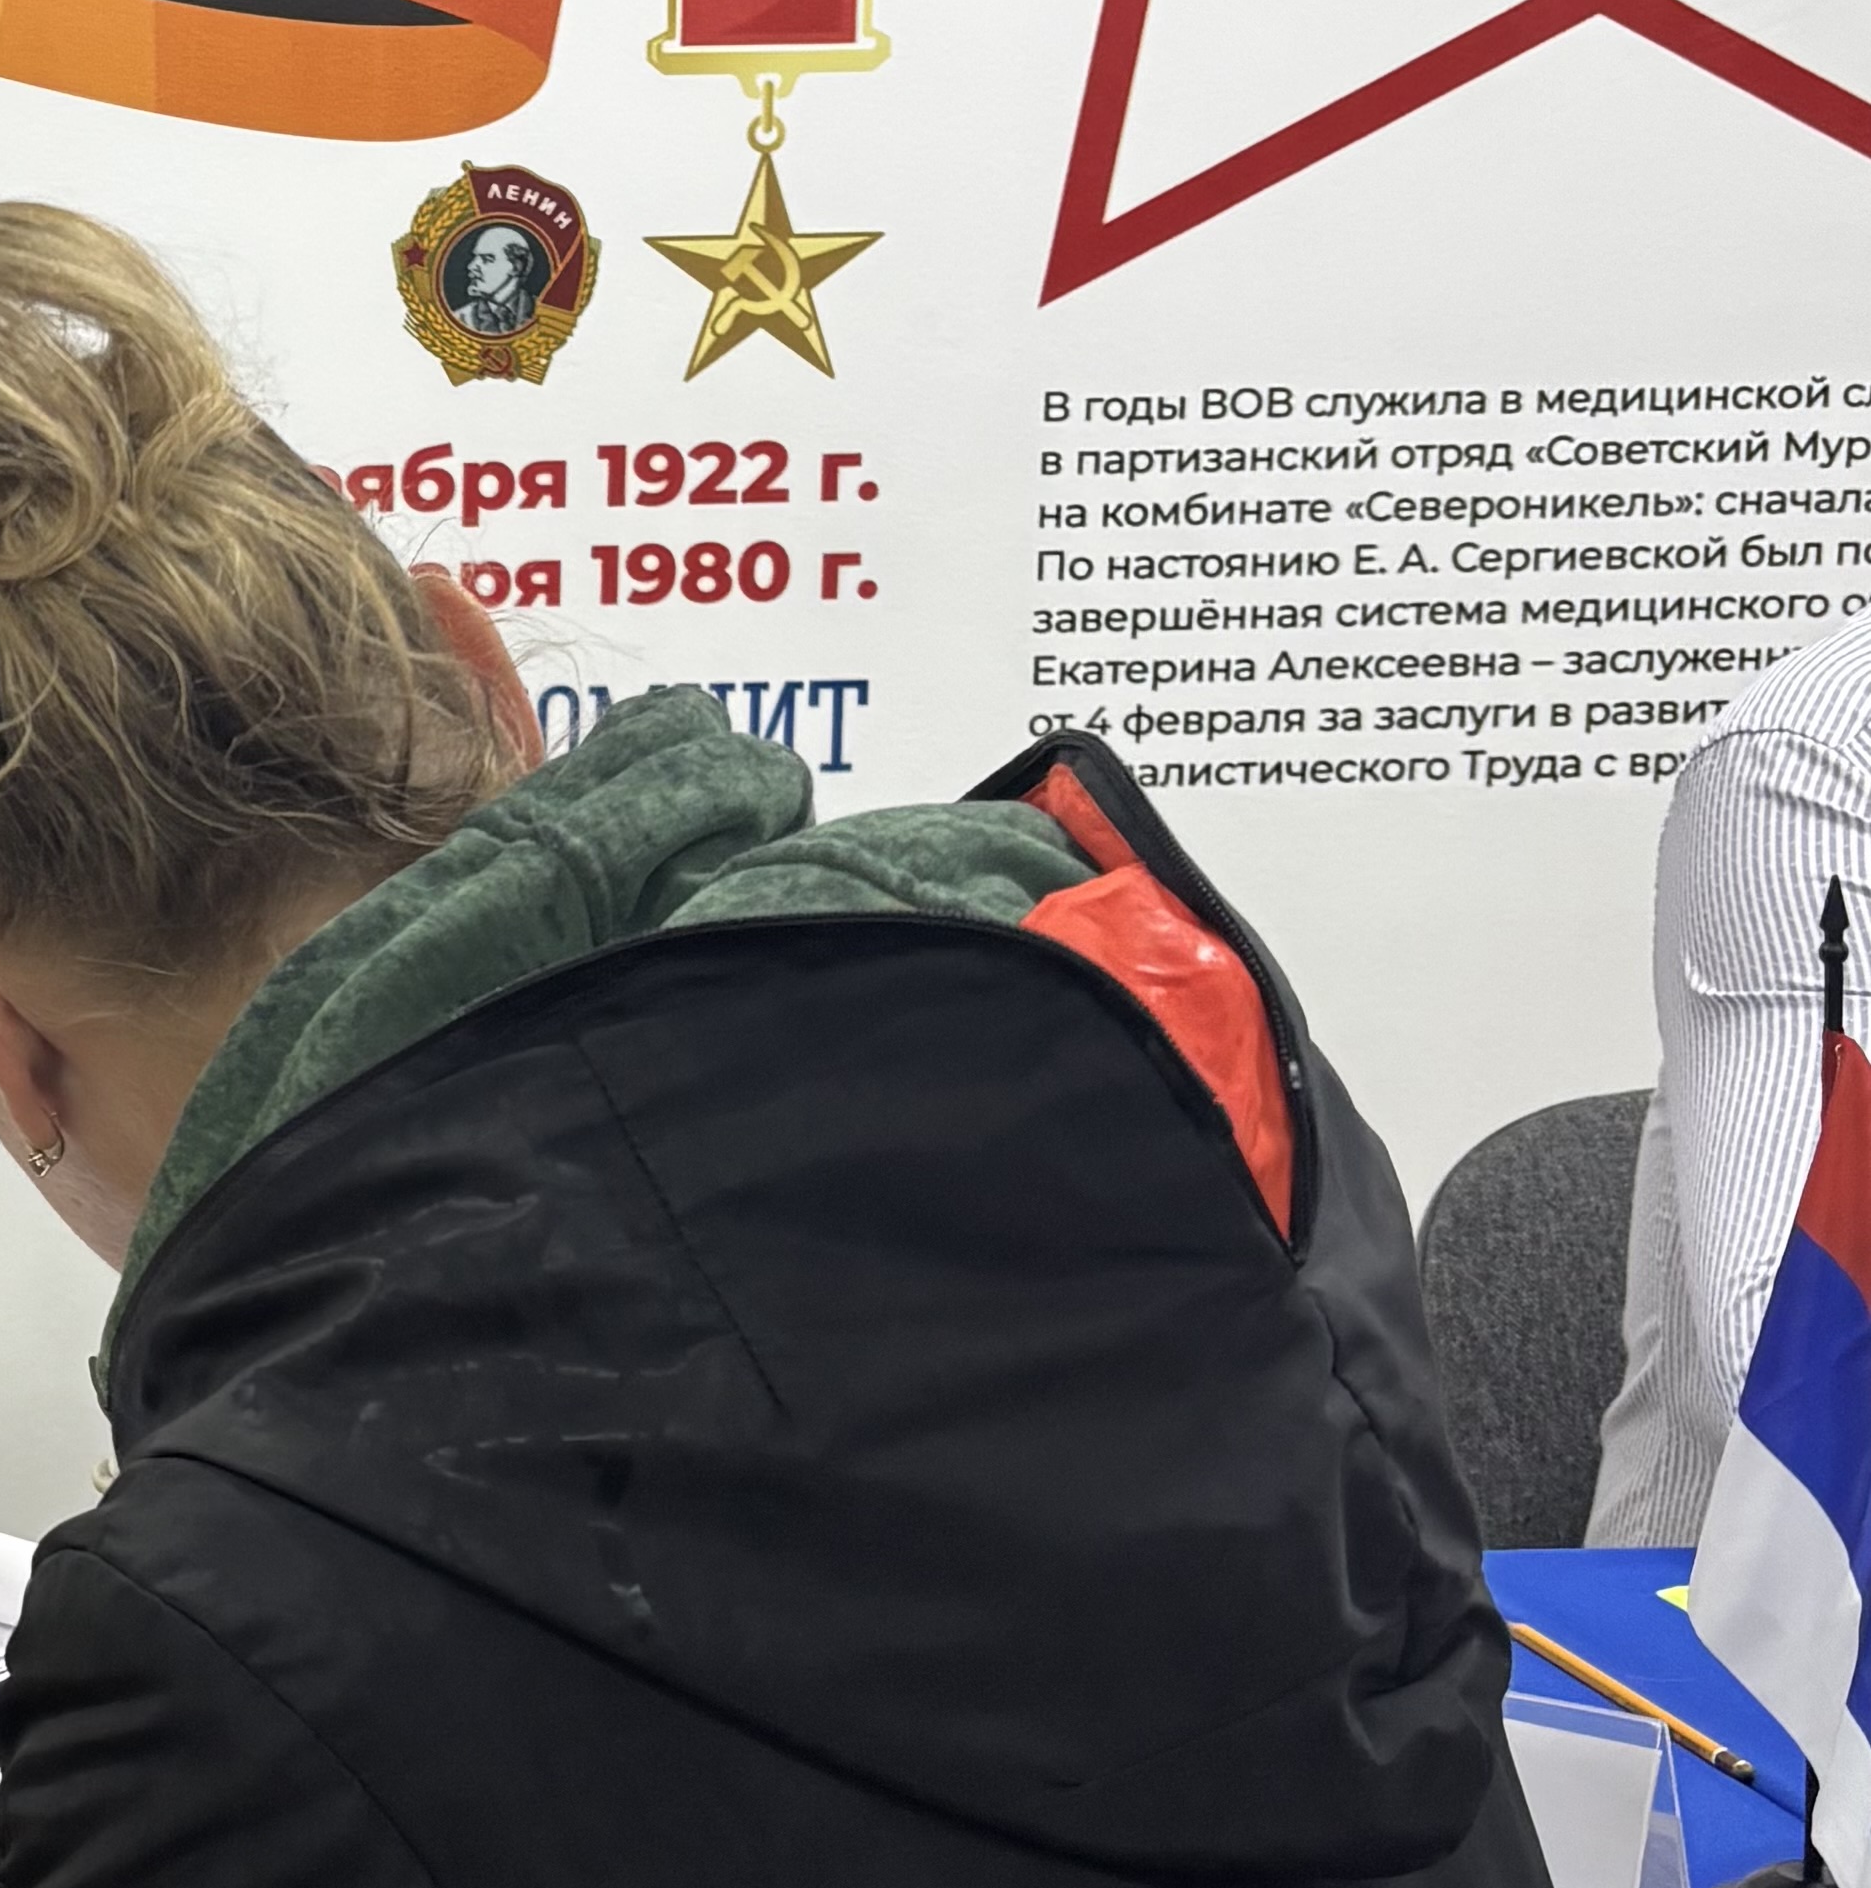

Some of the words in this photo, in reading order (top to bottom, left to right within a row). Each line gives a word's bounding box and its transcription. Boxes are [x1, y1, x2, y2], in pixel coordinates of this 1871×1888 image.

[487, 183, 573, 230] ЛЕНИН
[1043, 391, 1070, 423] В
[1085, 396, 1186, 426] годы
[1202, 387, 1294, 420] ВОВ
[1306, 390, 1487, 426] служила
[1500, 390, 1523, 415] в
[1537, 375, 1830, 418] медицинской
[1843, 383, 1871, 408] с
[1041, 451, 1062, 476] в
[1077, 437, 1378, 482] партизанский
[1390, 443, 1514, 476] отряд
[1525, 430, 1770, 467] «Советский
[1784, 430, 1871, 469] Мур
[309, 442, 566, 527] ября
[597, 440, 789, 507] 1922
[821, 452, 880, 502] г.
[1038, 504, 1087, 529] на
[1102, 491, 1332, 528] комбинате
[1345, 490, 1704, 528] «Североникель»:
[409, 559, 562, 609] ря
[590, 540, 790, 605] 1980
[821, 552, 879, 601] г.
[1037, 550, 1095, 582] По
[1107, 551, 1340, 581] настоянию
[1354, 543, 1387, 576] Е.
[1397, 543, 1439, 574] А.
[1451, 536, 1727, 580] Сергиевской
[1740, 533, 1823, 568] был
[1032, 598, 1323, 640] завершённая
[1335, 600, 1507, 629] система
[1521, 594, 1830, 628] медицинского
[1841, 594, 1871, 617] о
[1032, 655, 1256, 692] Екатерина
[1267, 650, 1520, 681] Алексеевна
[1562, 646, 1804, 681] заслуженн
[1029, 713, 1075, 736] от
[1085, 706, 1112, 736] 4
[1122, 703, 1306, 744] февраля
[1318, 707, 1362, 732] за
[1373, 704, 1536, 737] заслуги
[1550, 703, 1572, 727] в
[1129, 757, 1451, 788] алистического
[1461, 749, 1582, 788] Труда
[1594, 753, 1618, 778] с
[1629, 752, 1686, 784] вр
